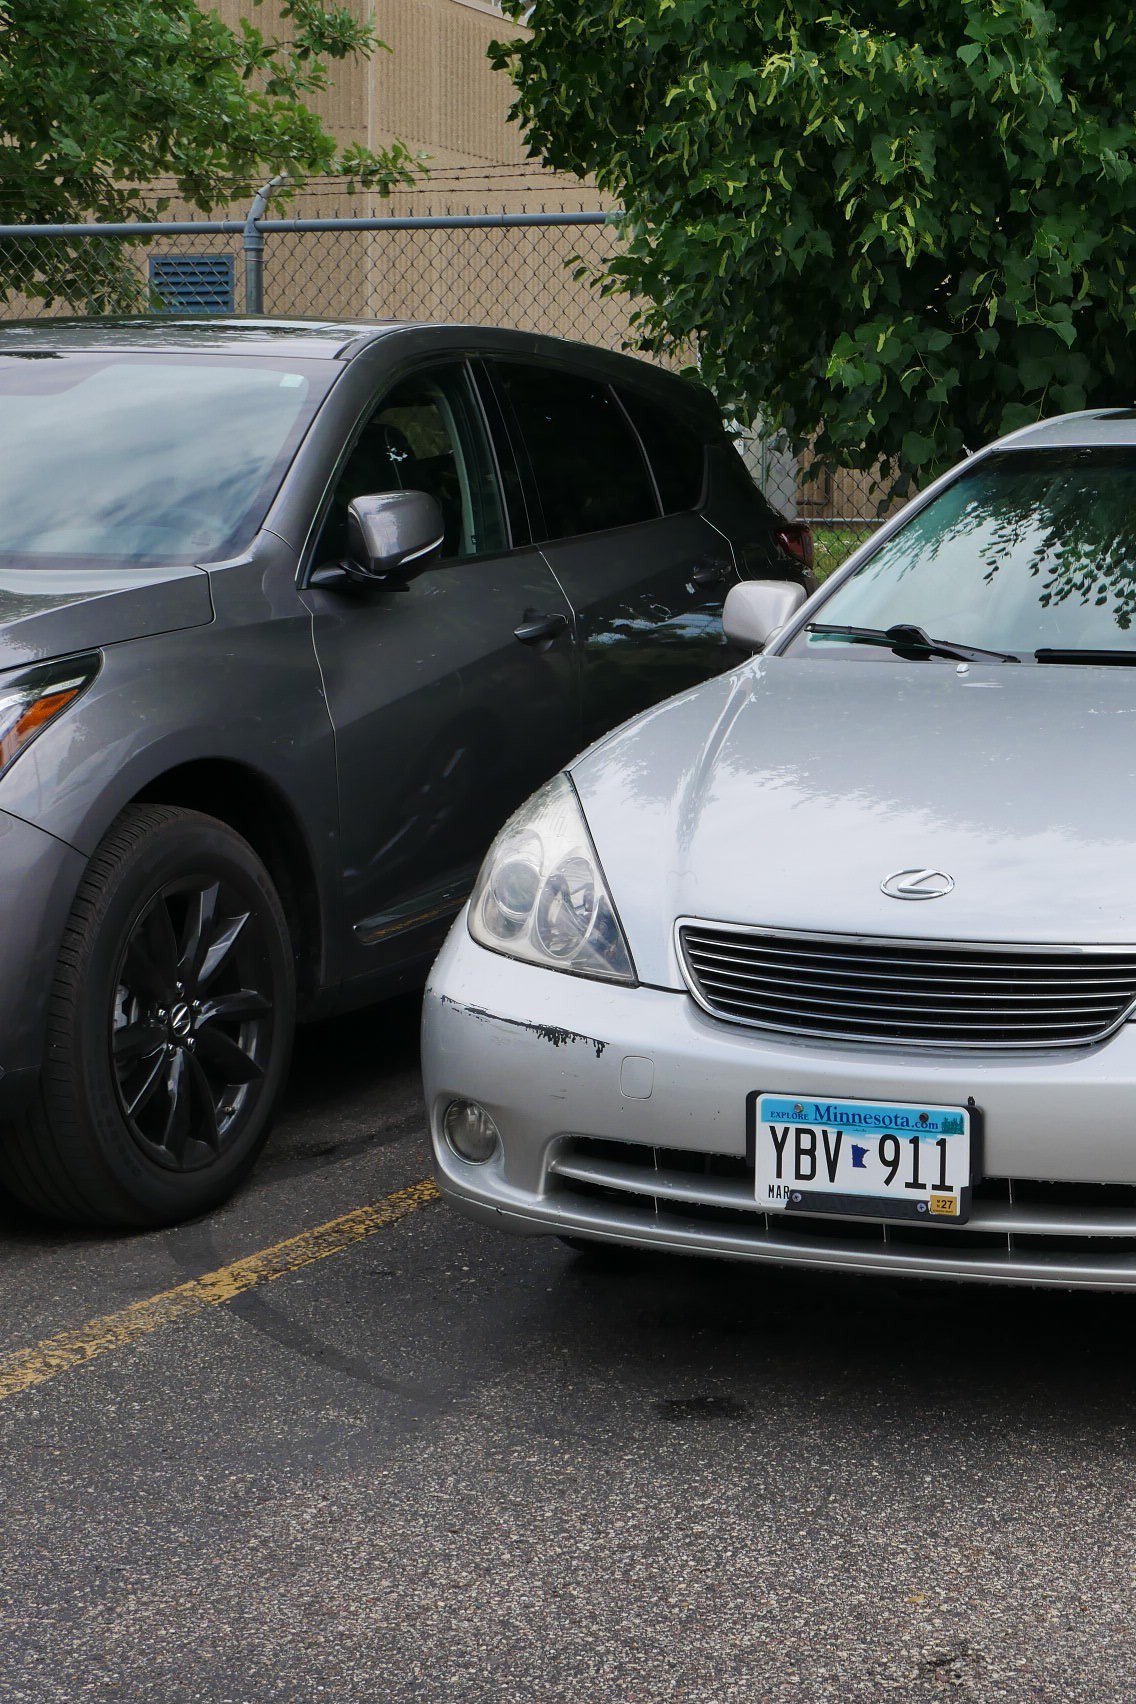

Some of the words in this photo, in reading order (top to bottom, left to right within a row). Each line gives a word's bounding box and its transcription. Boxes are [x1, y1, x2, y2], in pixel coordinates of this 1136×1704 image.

[770, 1110, 809, 1121] EXPLORE
[813, 1103, 939, 1130] Minnesota.com
[769, 1125, 843, 1184] YBV
[878, 1133, 954, 1193] 911
[768, 1183, 790, 1200] MAR
[941, 1199, 953, 1209] 27
